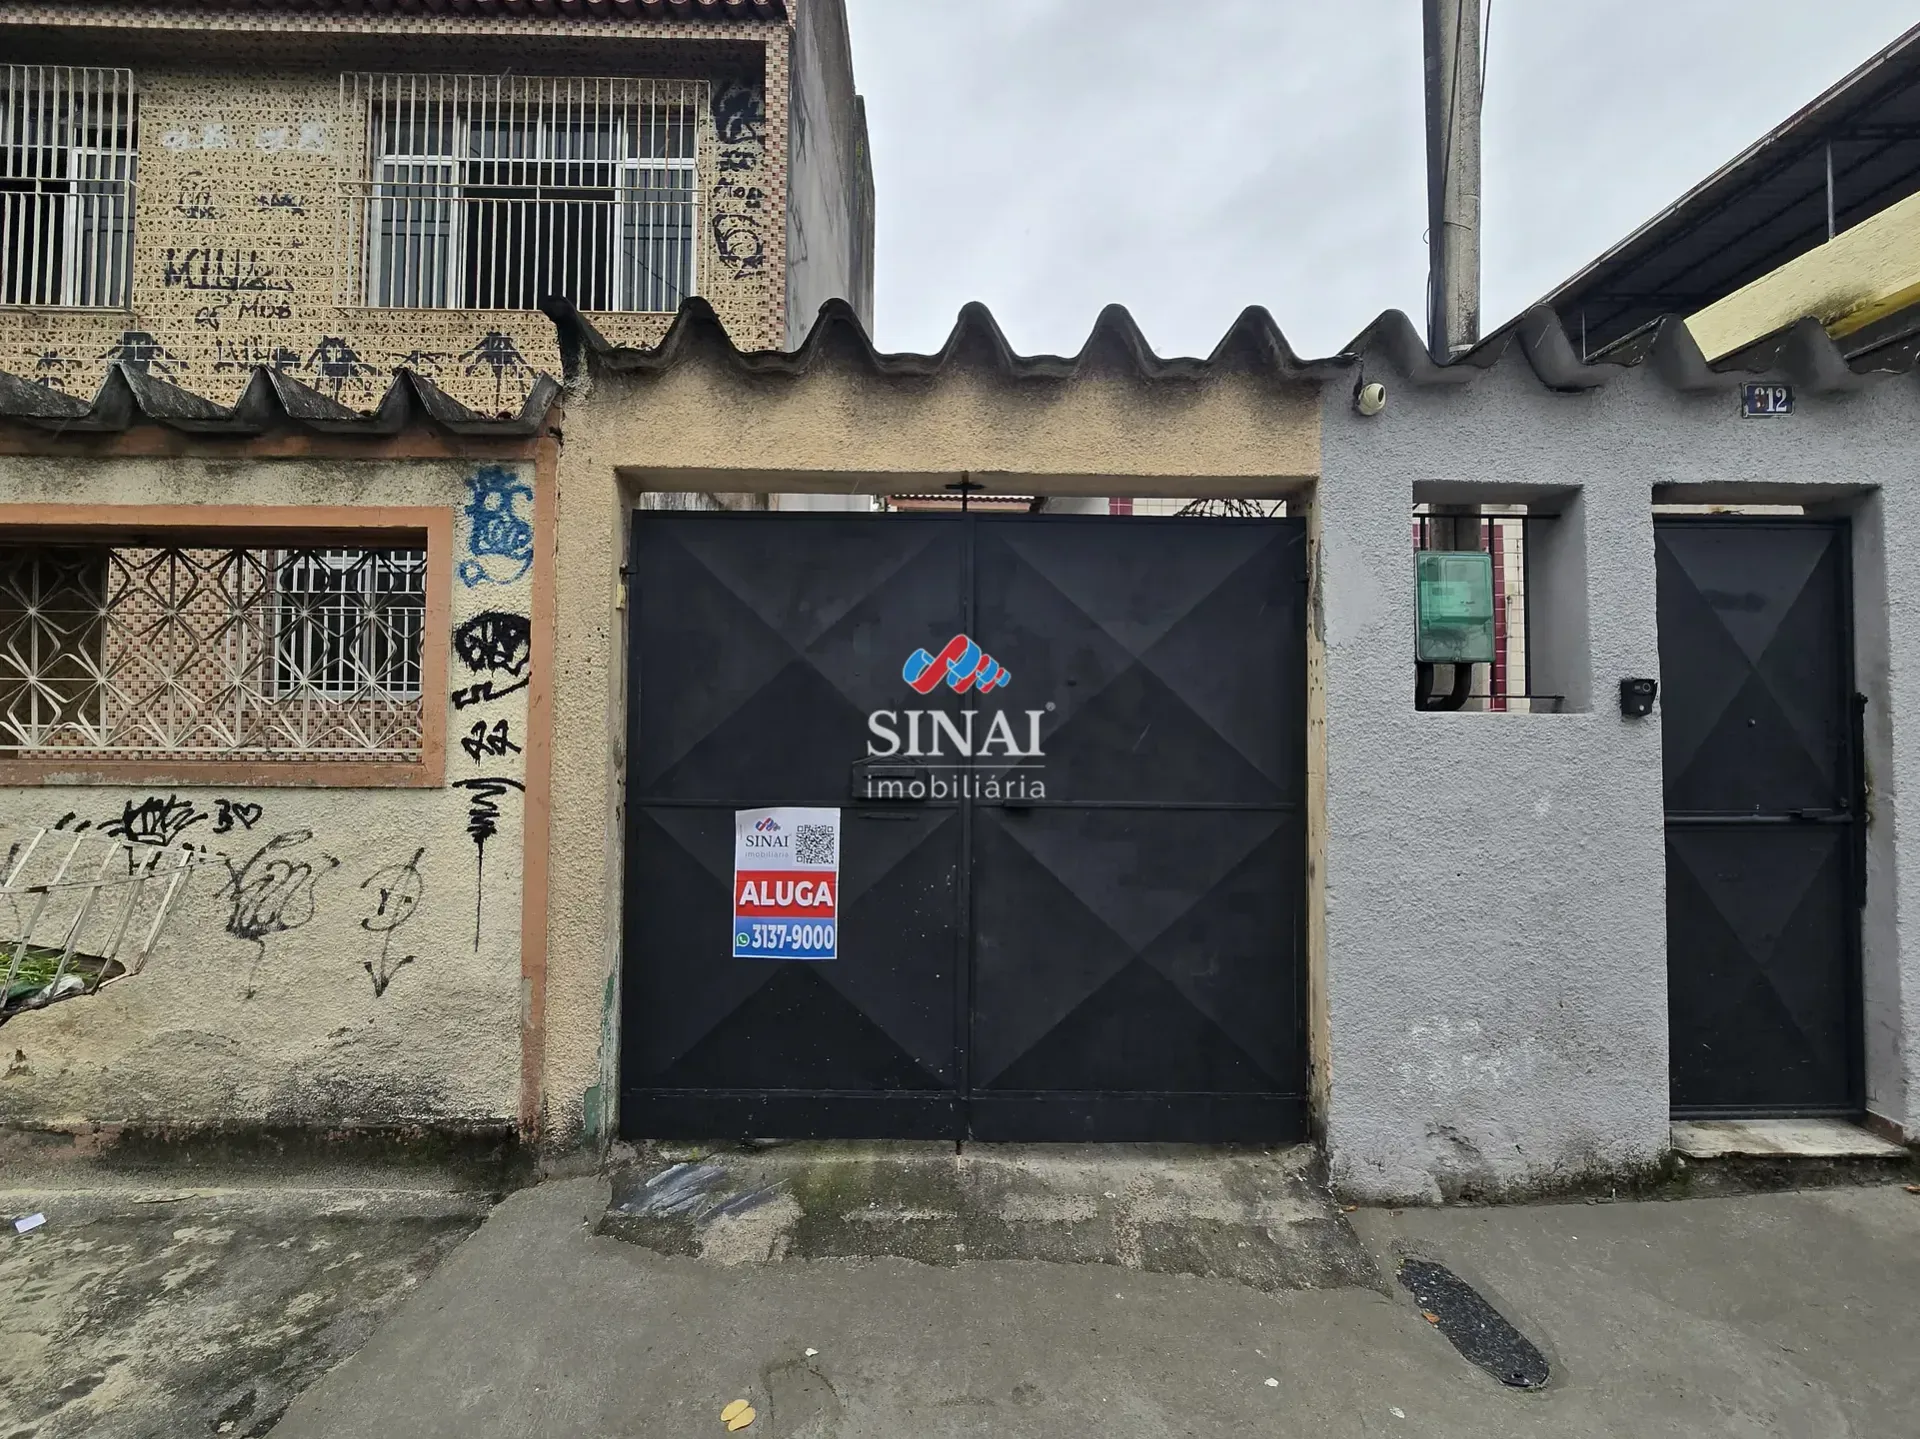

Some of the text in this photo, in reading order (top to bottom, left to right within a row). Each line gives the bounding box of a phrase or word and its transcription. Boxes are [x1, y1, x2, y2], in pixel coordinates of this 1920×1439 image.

[745, 834, 790, 848] SINAI
[739, 880, 834, 907] ALUGA
[751, 923, 834, 950] 3137-9000
